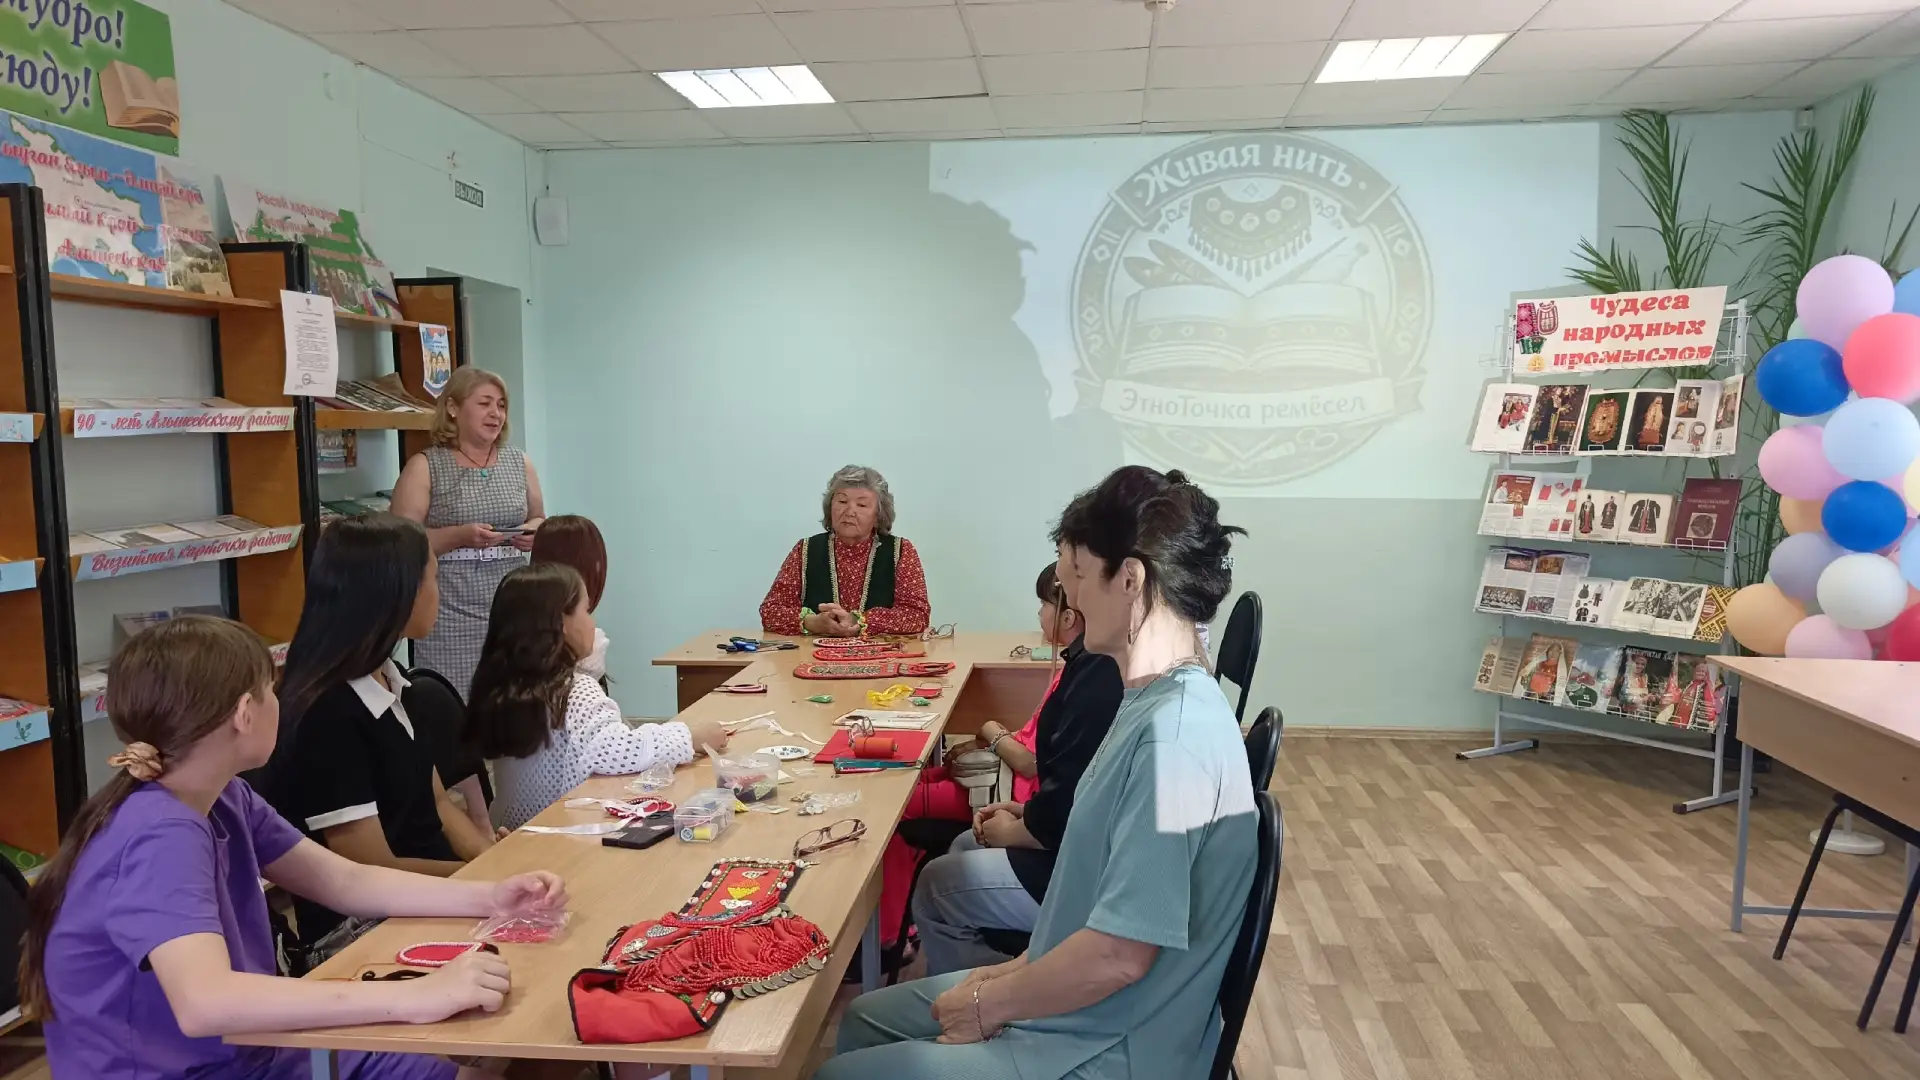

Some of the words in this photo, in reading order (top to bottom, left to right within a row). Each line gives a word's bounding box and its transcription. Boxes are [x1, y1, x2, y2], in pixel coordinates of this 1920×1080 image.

[0, 50, 91, 114] юду!
[1133, 144, 1261, 206] Живая
[1273, 145, 1352, 189] нить
[1590, 293, 1690, 318] Чудеса
[1563, 318, 1707, 344] народных
[1553, 345, 1714, 370] промыслов
[77, 413, 95, 430] 90
[111, 412, 141, 429] лет
[146, 411, 245, 430] Альшеевскому
[246, 410, 290, 430] району
[1119, 387, 1251, 420] ЭтноТочка
[1261, 395, 1367, 424] ремёсел
[91, 549, 175, 575] Визитная
[178, 537, 246, 561] карточка
[249, 531, 292, 552] района
